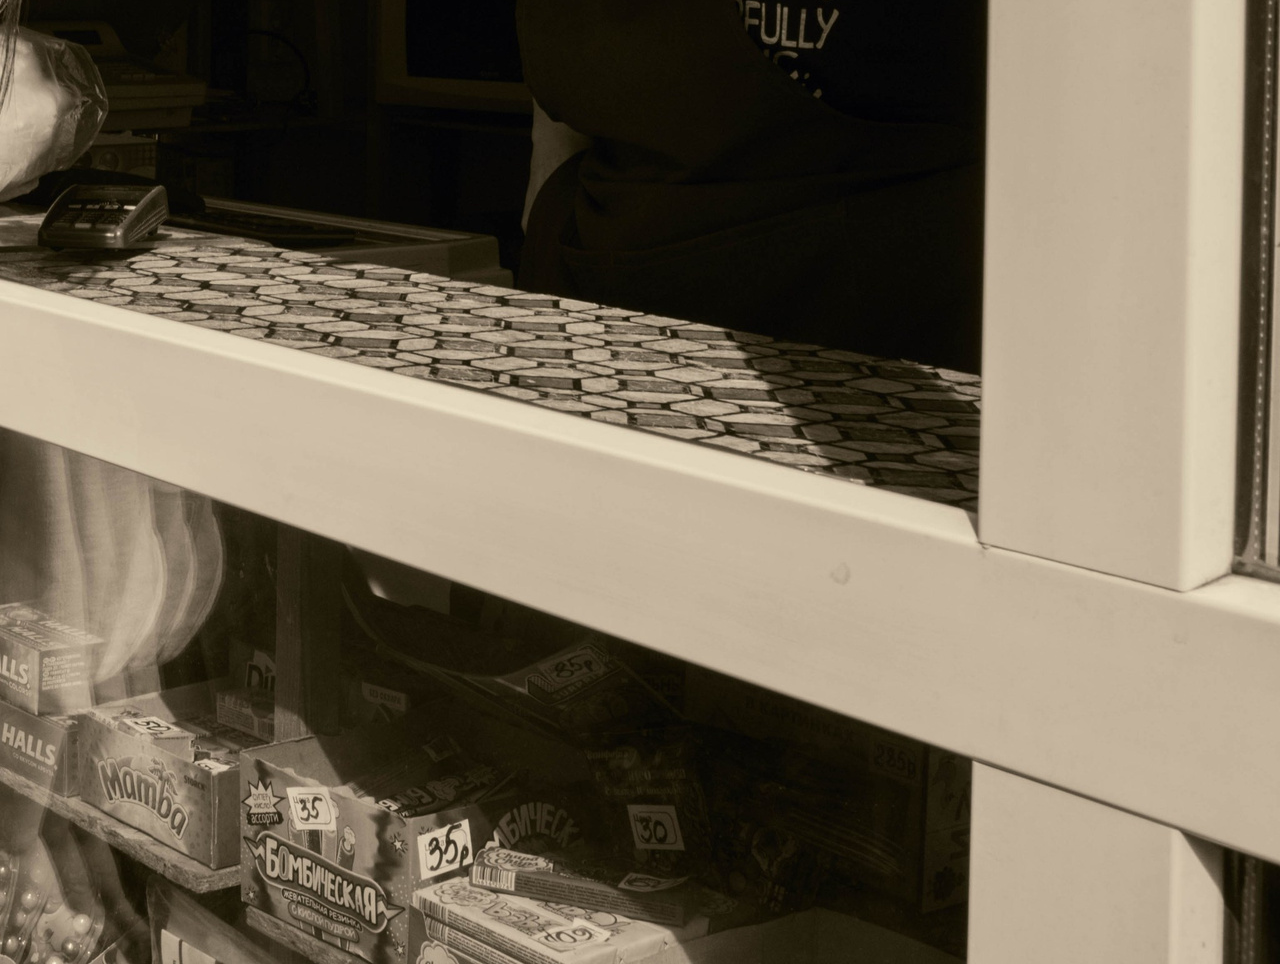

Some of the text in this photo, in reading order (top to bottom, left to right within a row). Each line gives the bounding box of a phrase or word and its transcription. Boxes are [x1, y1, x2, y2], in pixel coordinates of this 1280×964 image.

[1, 722, 57, 765] HALLS
[98, 759, 188, 839] Mamba
[300, 796, 323, 822] 35
[639, 817, 668, 845] 30
[265, 837, 377, 924] БОМБИЧЕСКАЯ
[283, 890, 361, 929] ЖЕВАТЕЛЬНАЯ РЕЗИНКА
[323, 918, 357, 939] ПУДРОЙ
